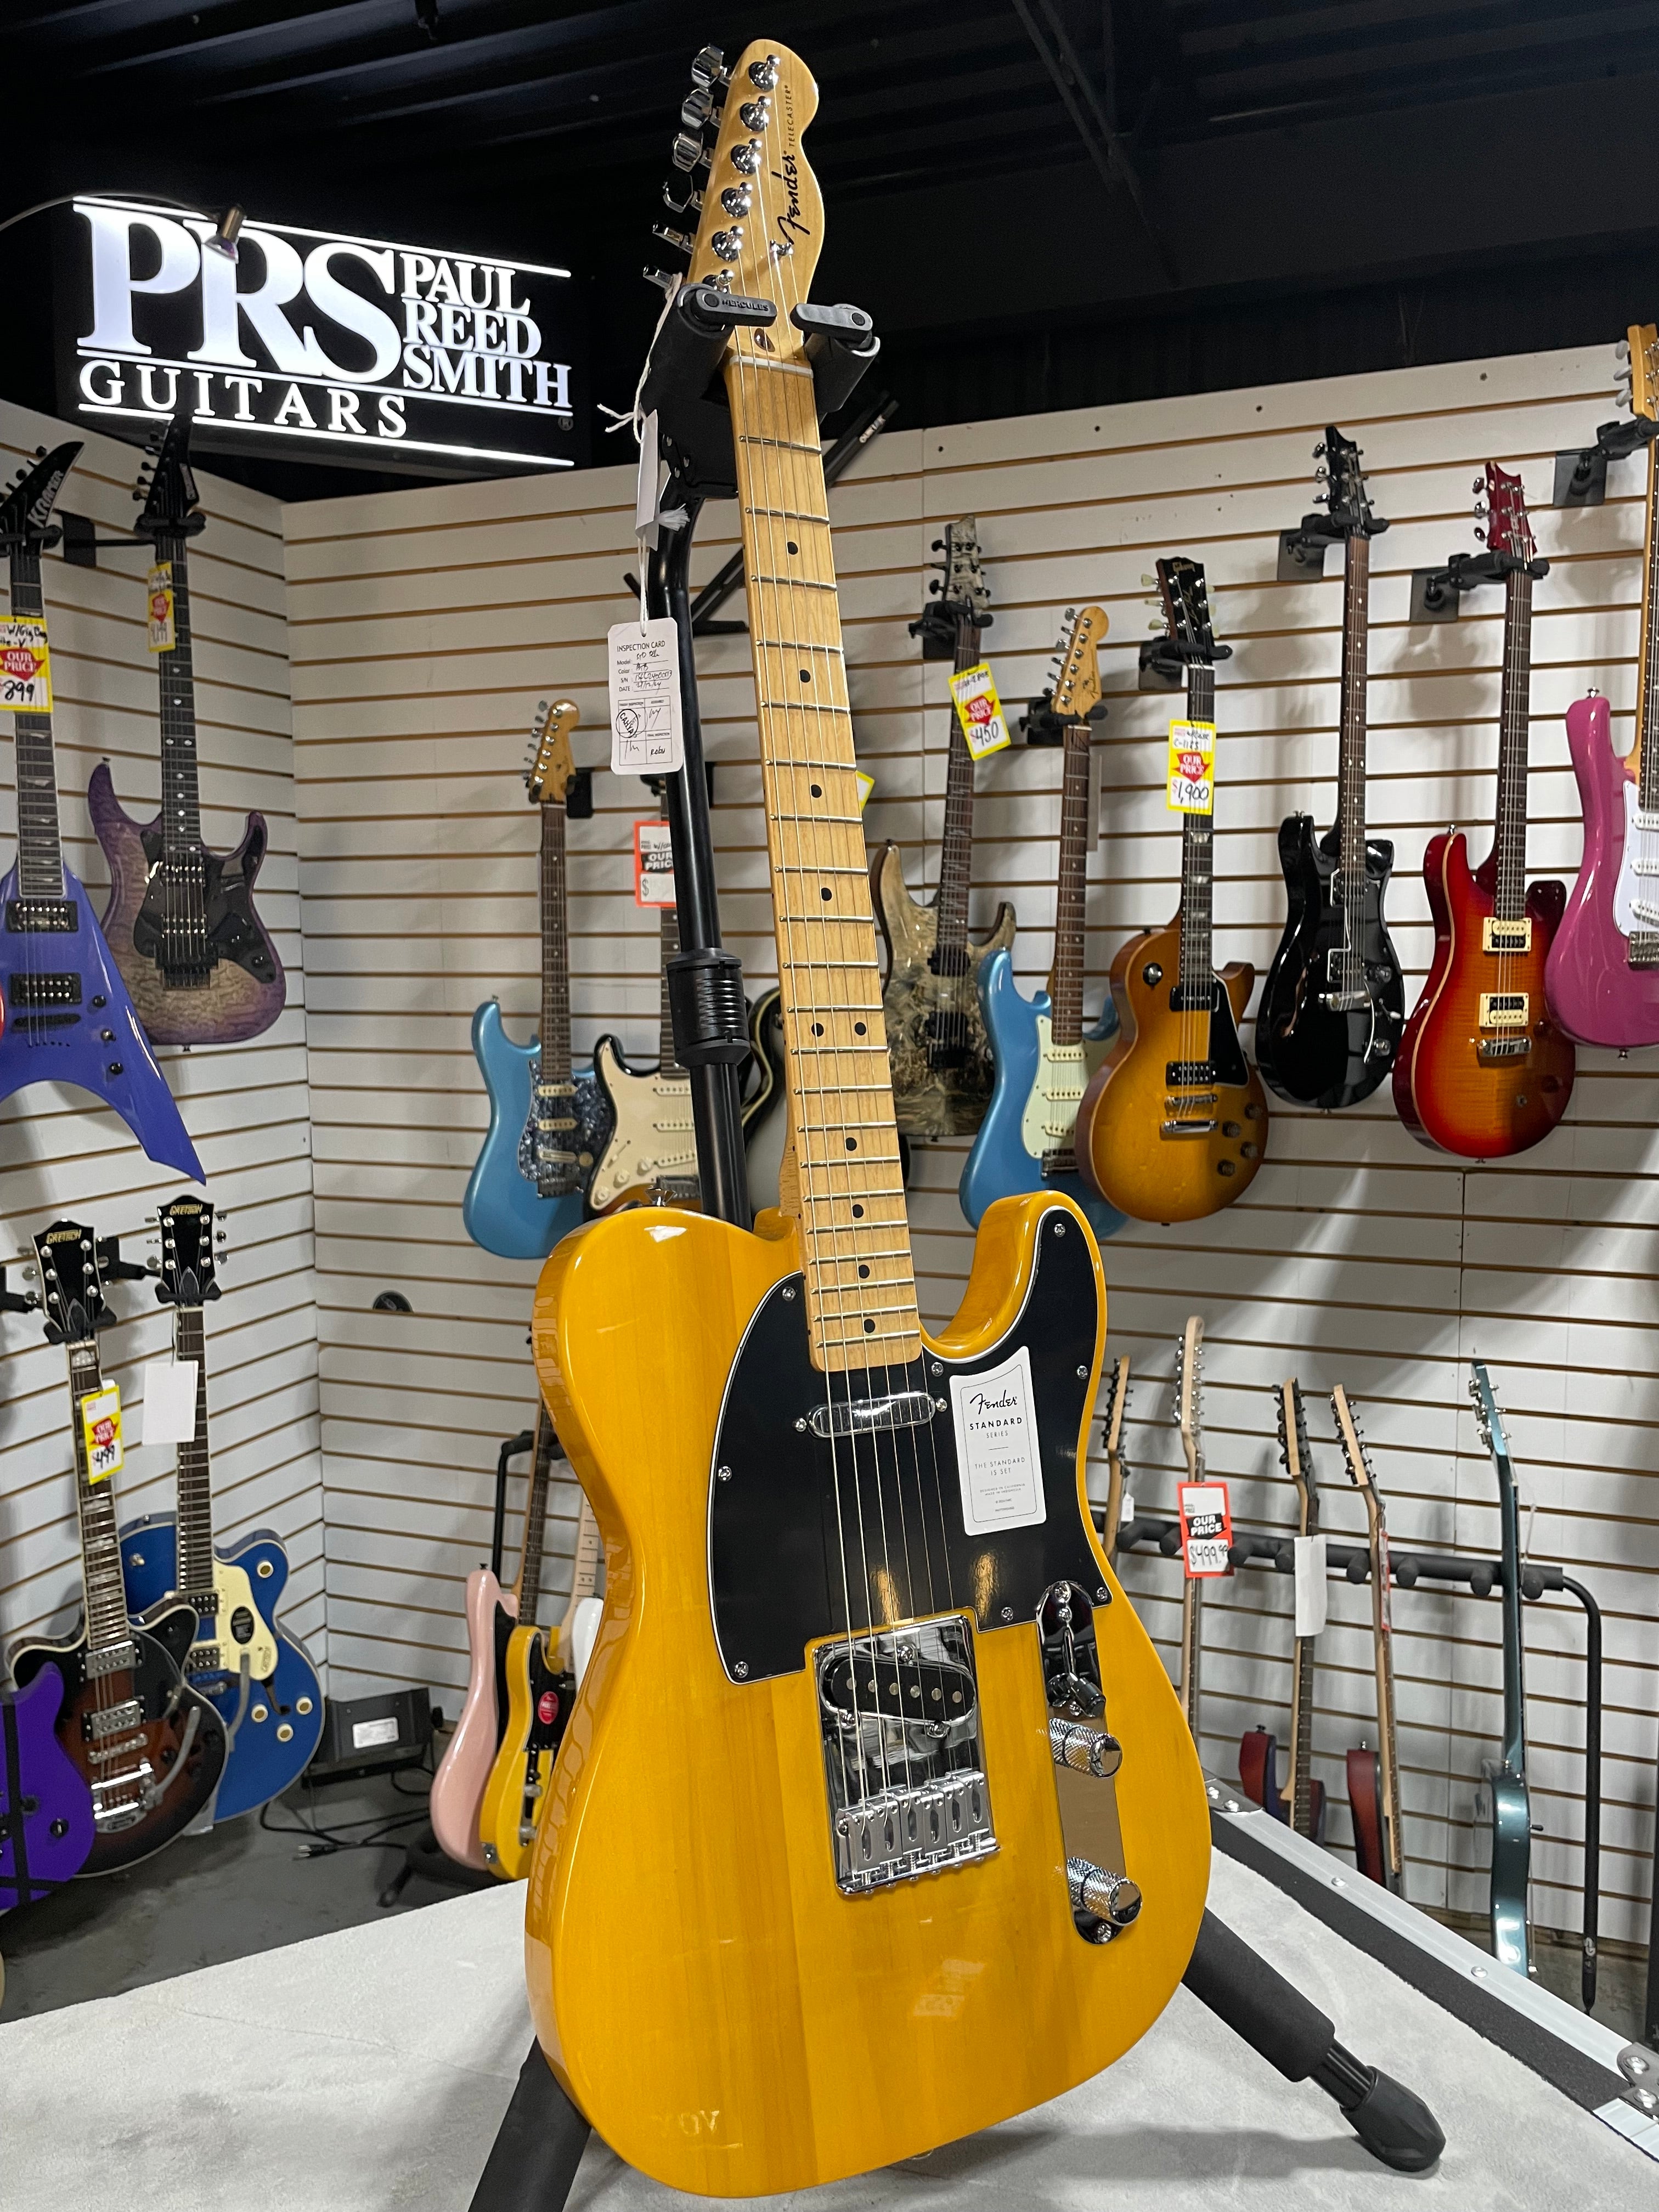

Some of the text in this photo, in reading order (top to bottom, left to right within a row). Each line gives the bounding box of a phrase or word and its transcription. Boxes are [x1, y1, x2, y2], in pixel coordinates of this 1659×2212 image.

[785, 88, 795, 147] TELECASTER
[771, 154, 810, 245] Fender
[400, 252, 531, 315] PAUL
[73, 203, 402, 383] PRS
[722, 299, 769, 312] HERCULES
[402, 297, 541, 359] REED
[403, 345, 573, 409] SMITH
[78, 360, 408, 438] GUITARS
[617, 640, 665, 652] INSPECTION CARD
[7, 651, 32, 662] OUR
[1183, 754, 1201, 766] OUR
[1180, 763, 1205, 776] PRICE
[648, 852, 673, 862] OUR
[645, 860, 673, 871] PRIC
[969, 1389, 1018, 1415] Fender
[969, 1417, 1022, 1430] STANDARD
[986, 1430, 1008, 1438] SERIES
[990, 1457, 1025, 1467] STANDARD
[1193, 1515, 1216, 1527] OUR
[1190, 1522, 1222, 1537] PRICE
